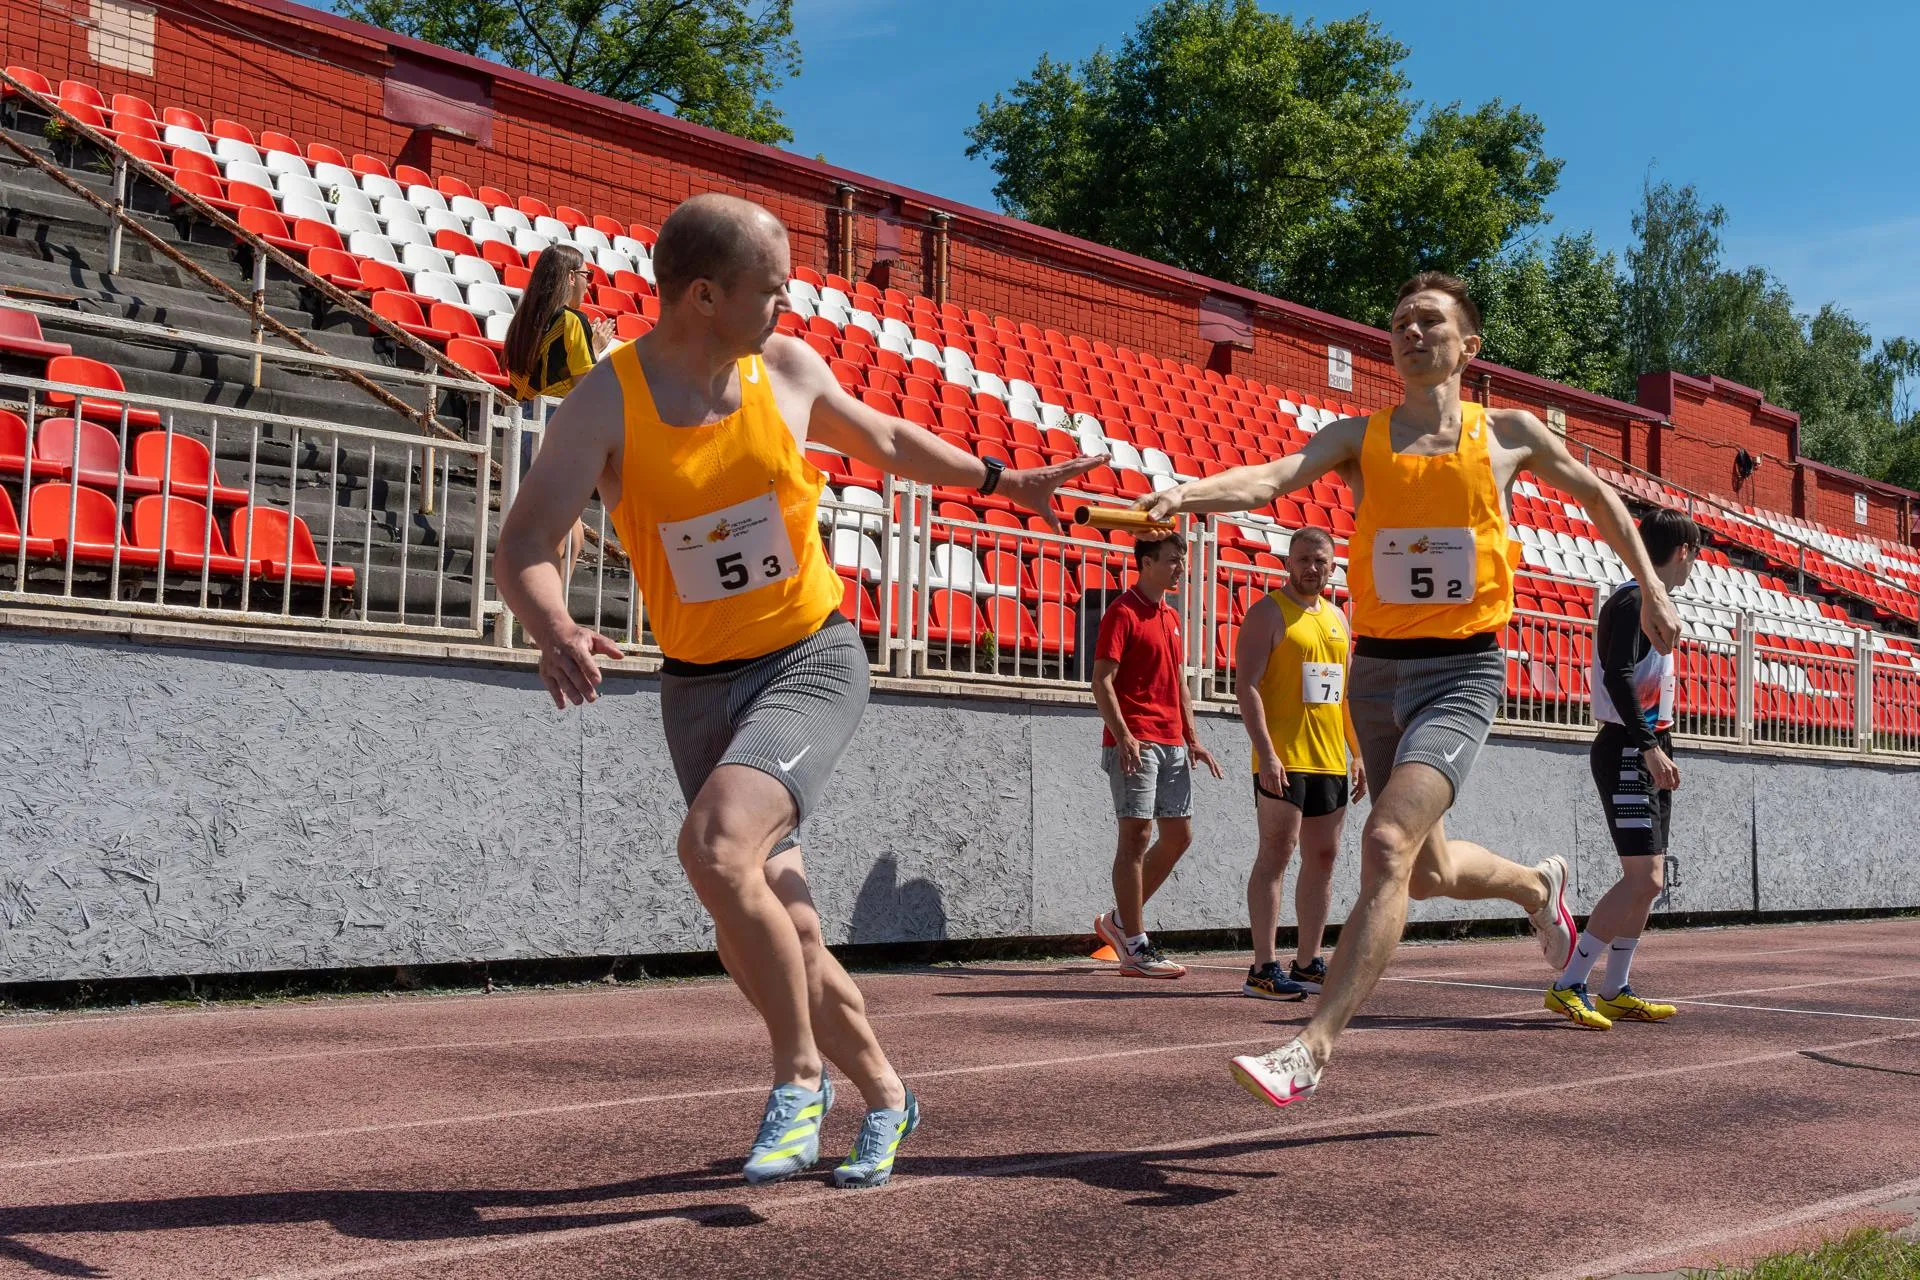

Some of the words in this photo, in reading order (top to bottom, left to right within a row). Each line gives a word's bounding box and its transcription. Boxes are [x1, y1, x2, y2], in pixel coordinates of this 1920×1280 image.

[716, 552, 749, 590] 5
[762, 555, 781, 578] 3
[1410, 568, 1434, 599] 5
[1447, 579, 1462, 598] 2
[1321, 683, 1331, 701] 7
[1334, 691, 1340, 702] 3
